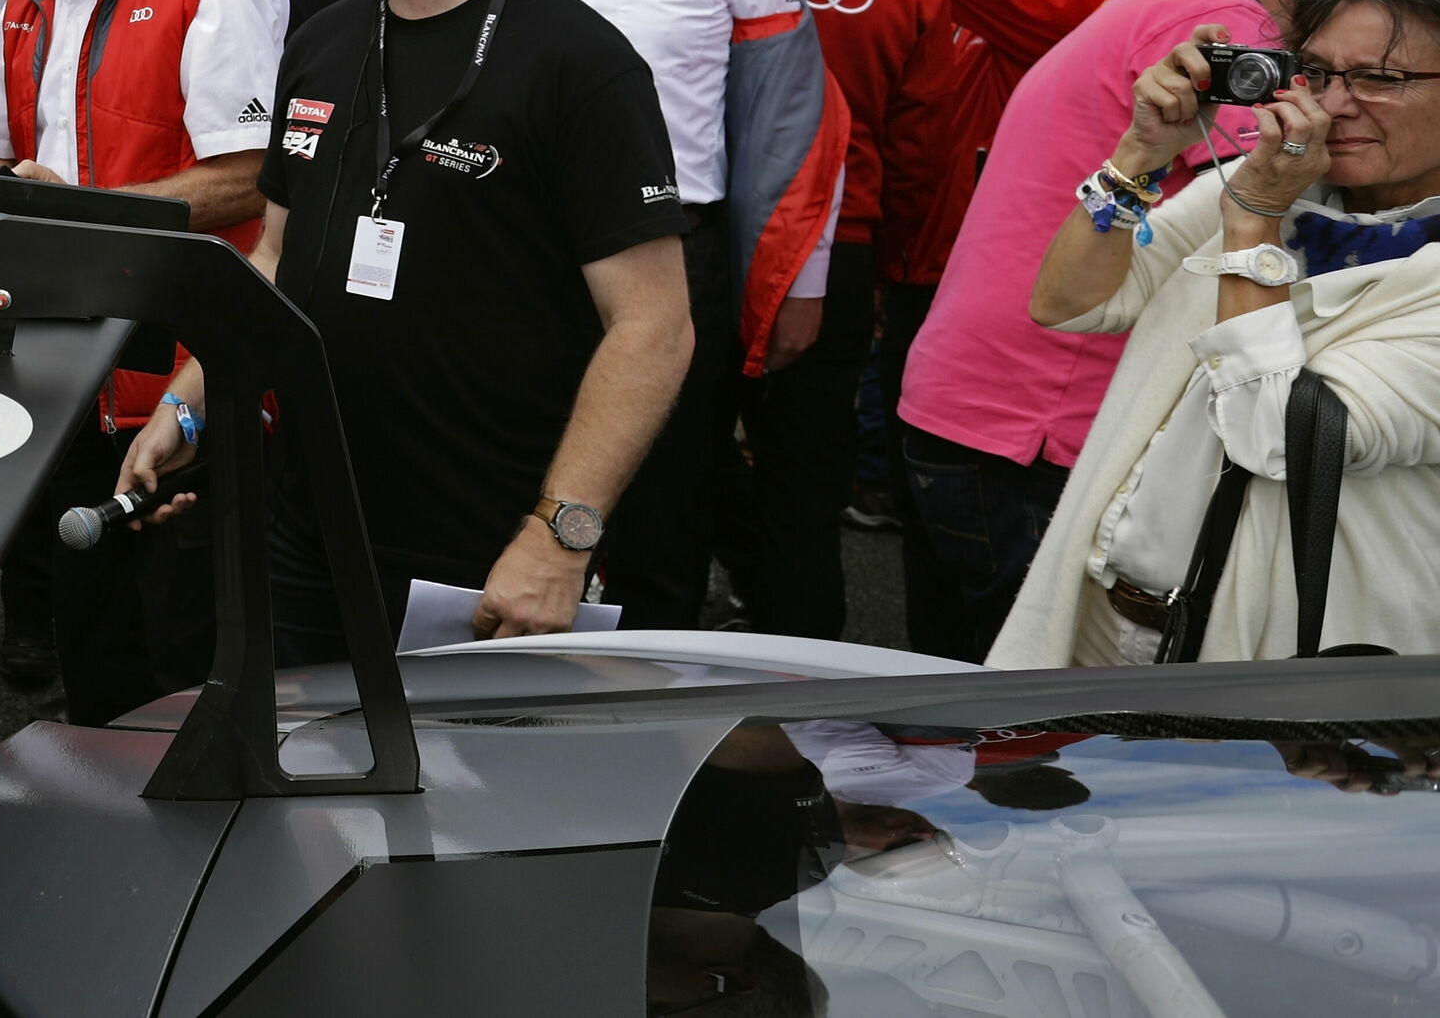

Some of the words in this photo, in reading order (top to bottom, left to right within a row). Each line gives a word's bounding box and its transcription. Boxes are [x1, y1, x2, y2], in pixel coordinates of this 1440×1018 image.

[295, 103, 327, 118] TOTAL
[422, 139, 486, 164] BLANCPAIN
[425, 153, 439, 163] GT
[438, 157, 472, 173] SERIES
